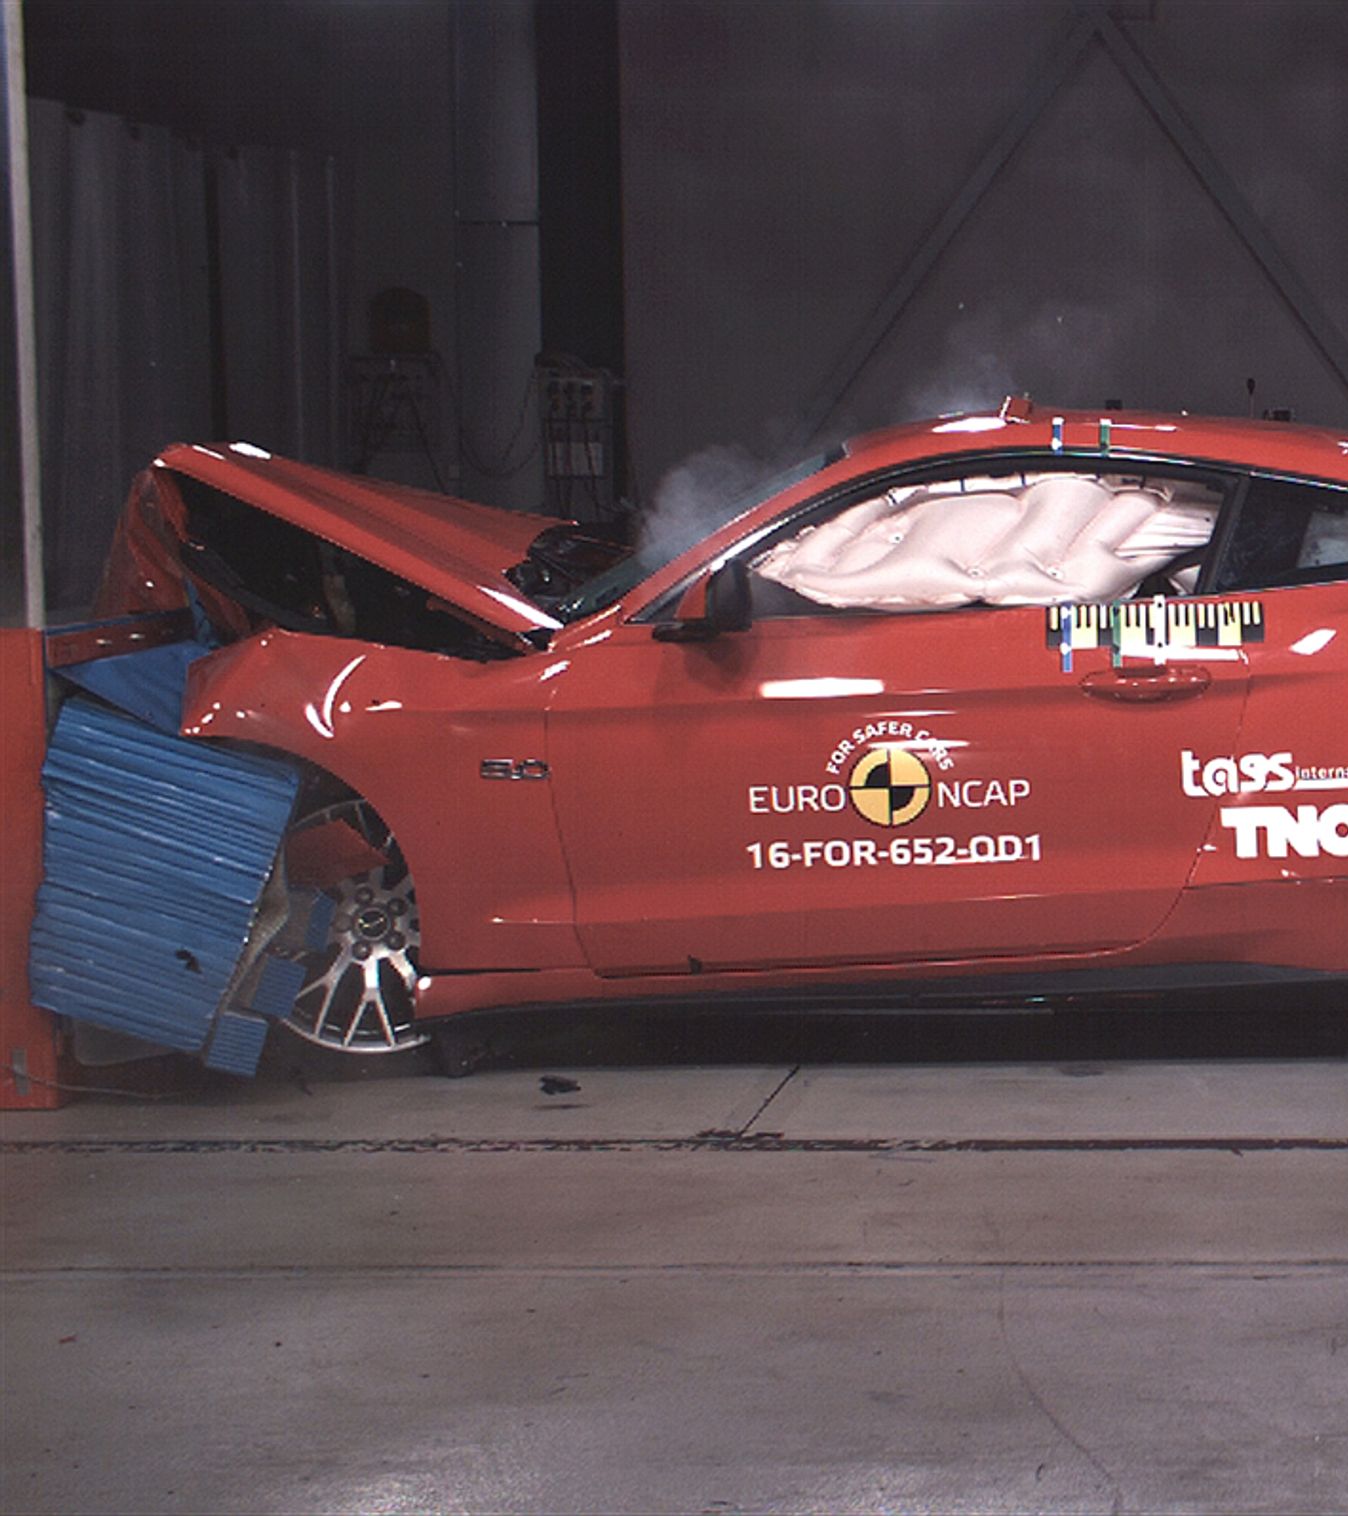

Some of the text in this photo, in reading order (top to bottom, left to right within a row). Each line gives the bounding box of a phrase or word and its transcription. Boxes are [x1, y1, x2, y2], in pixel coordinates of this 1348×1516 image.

[826, 720, 954, 775] FOR SAFER CARS
[749, 779, 1031, 813] EURO NCAP
[1181, 750, 1295, 797] tass
